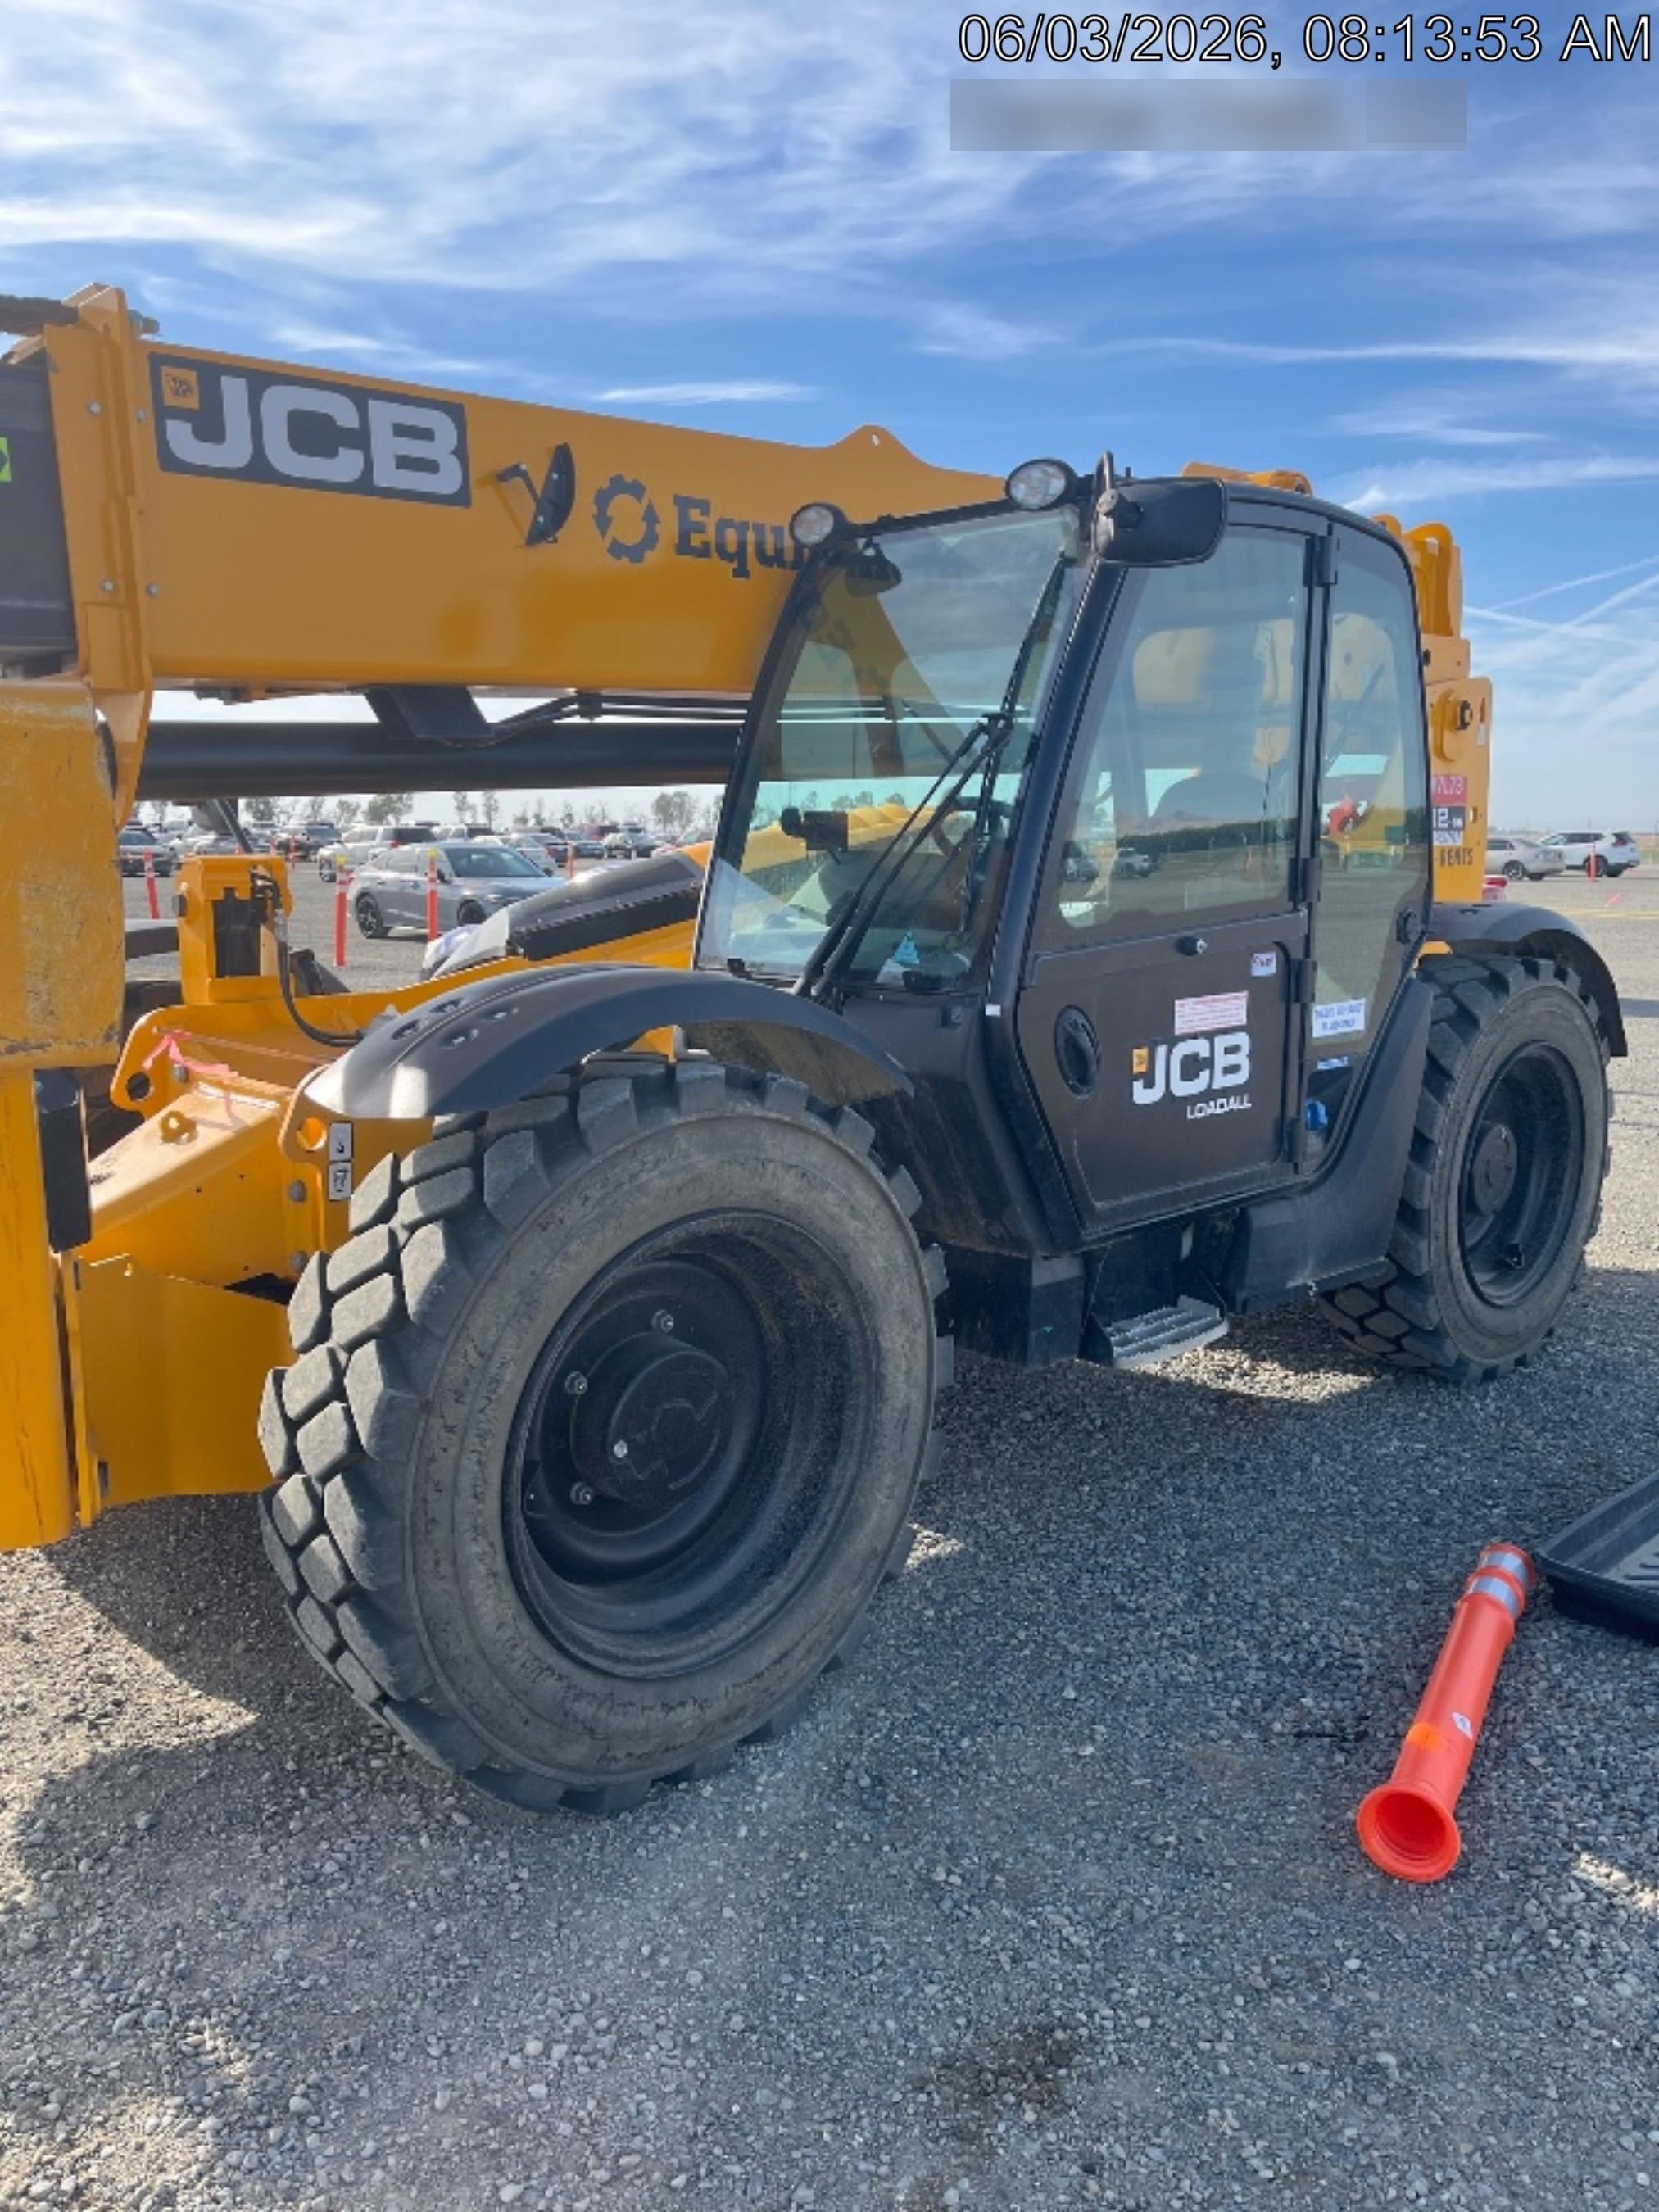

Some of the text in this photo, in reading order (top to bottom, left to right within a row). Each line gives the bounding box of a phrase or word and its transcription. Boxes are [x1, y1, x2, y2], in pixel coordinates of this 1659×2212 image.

[165, 374, 465, 496] JCB
[1132, 1031, 1251, 1104] JCB
[1186, 1094, 1252, 1119] LOADALL
